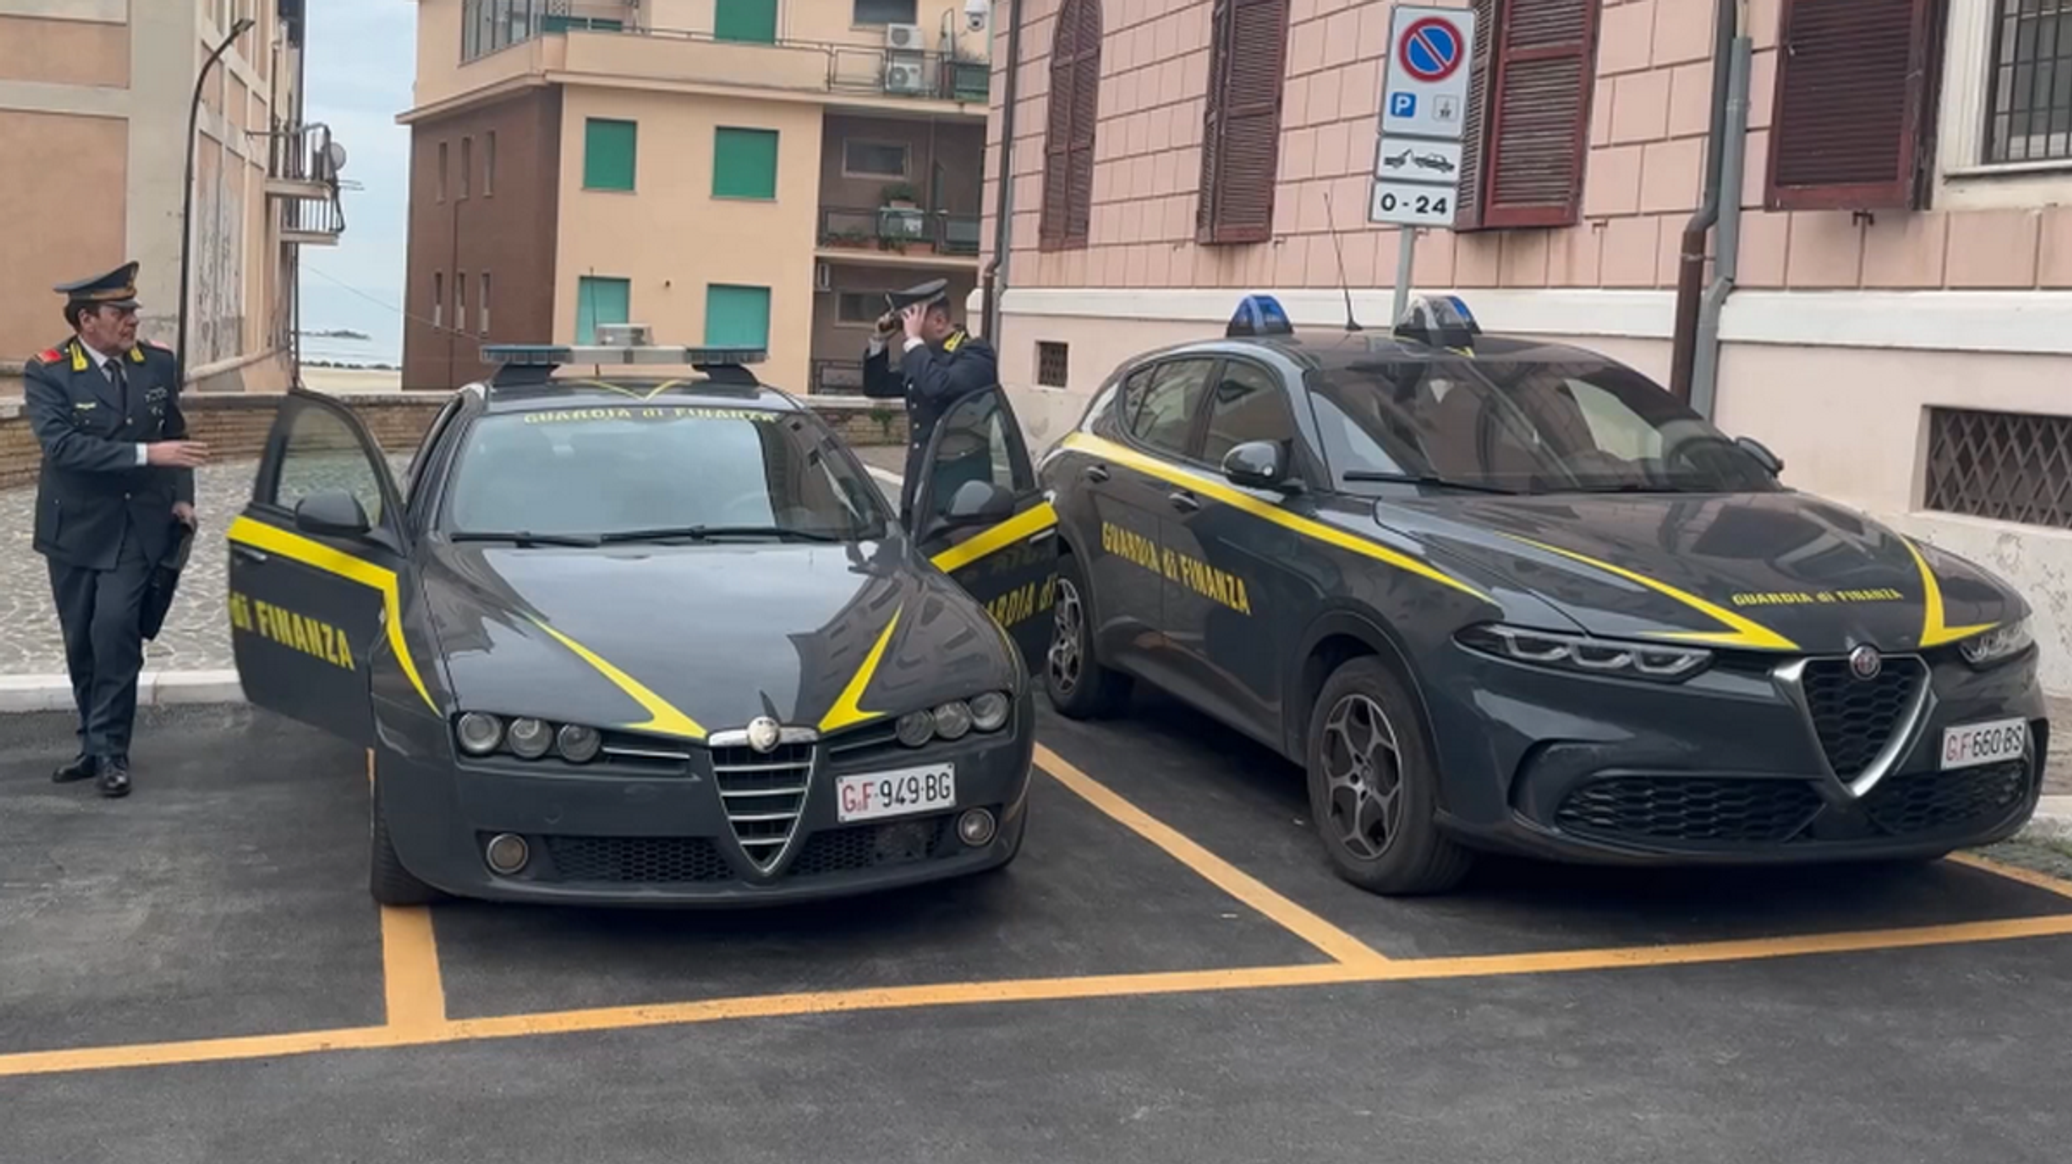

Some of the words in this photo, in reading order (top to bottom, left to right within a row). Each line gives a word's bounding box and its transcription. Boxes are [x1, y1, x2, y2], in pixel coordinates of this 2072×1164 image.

[1395, 95, 1411, 115] P
[524, 408, 631, 424] GUARDIA
[642, 407, 663, 418] di
[675, 408, 777, 423] FINANZA
[1102, 521, 1161, 574] GUARDIA
[1163, 547, 1180, 583] di
[1179, 553, 1252, 616] FINANZA
[1732, 591, 1814, 606] GUARDIA
[1816, 591, 1836, 602] di
[1836, 588, 1903, 602] FINANZA
[229, 591, 252, 631] di
[255, 600, 355, 671] FINANZA
